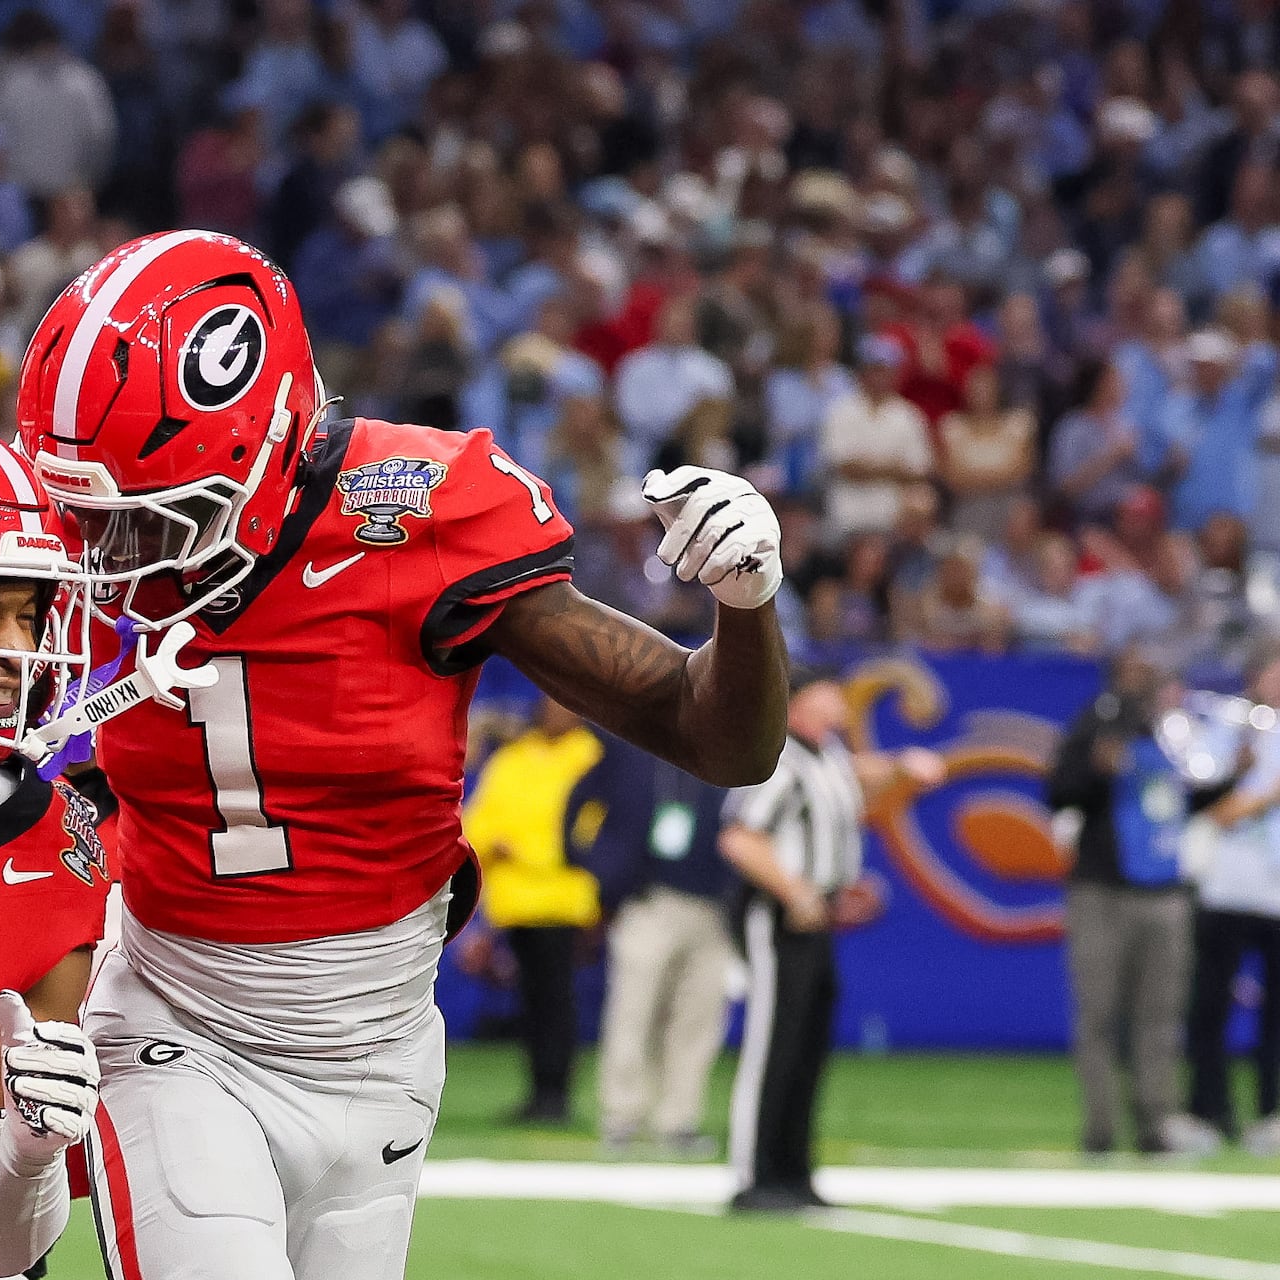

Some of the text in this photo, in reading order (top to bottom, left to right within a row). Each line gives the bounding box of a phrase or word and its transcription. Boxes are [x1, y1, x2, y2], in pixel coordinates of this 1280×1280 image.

[351, 472, 427, 491] Allstate
[490, 453, 554, 525] 1
[186, 654, 294, 879] 1
